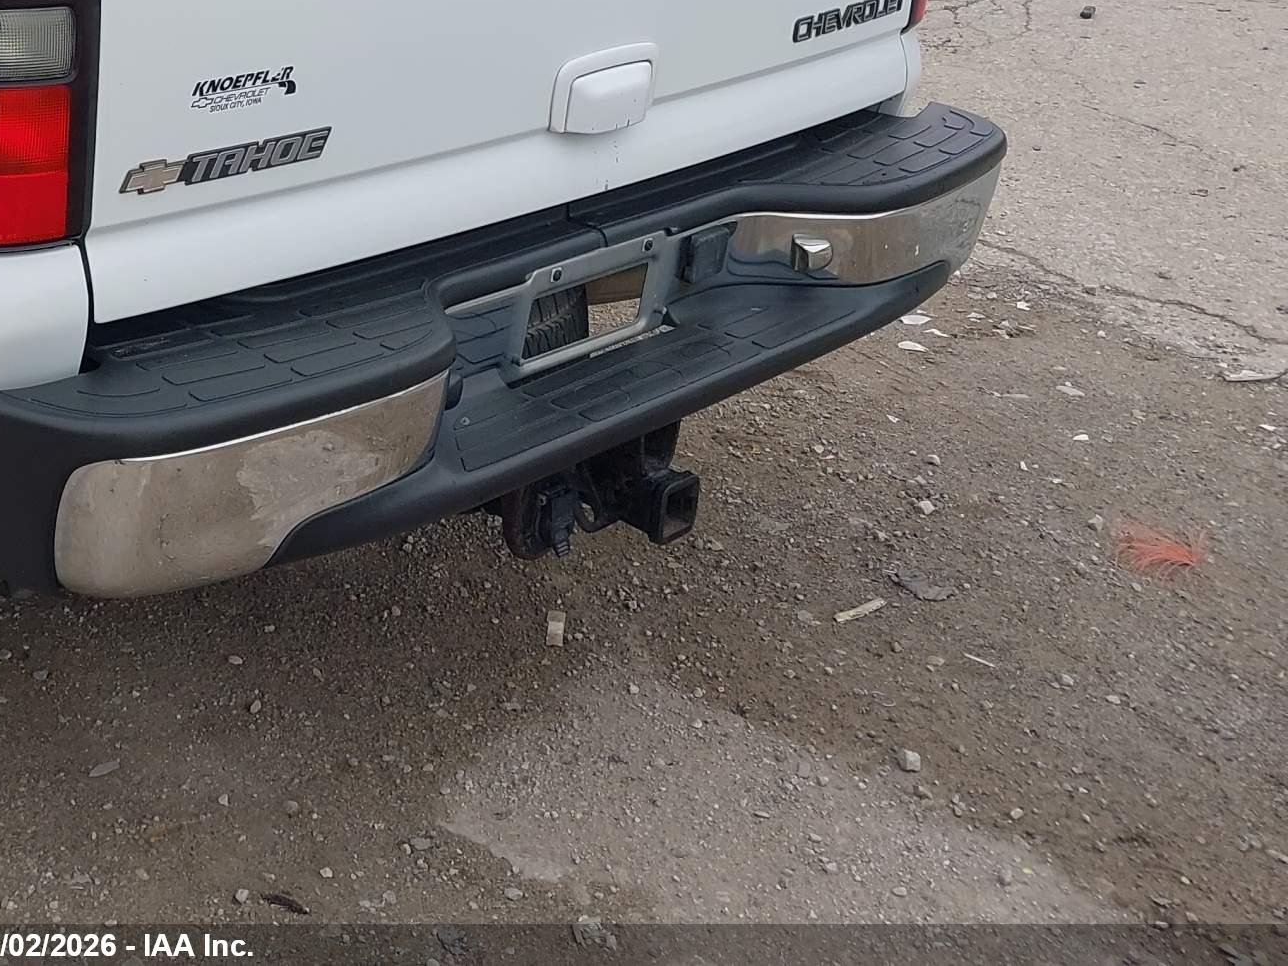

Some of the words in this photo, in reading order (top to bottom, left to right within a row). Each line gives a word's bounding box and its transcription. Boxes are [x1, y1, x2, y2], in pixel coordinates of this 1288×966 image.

[213, 87, 272, 104] CHEVROLET
[209, 101, 229, 113] SIOUX
[246, 97, 262, 107] IOWA
[189, 128, 331, 184] TAHOE
